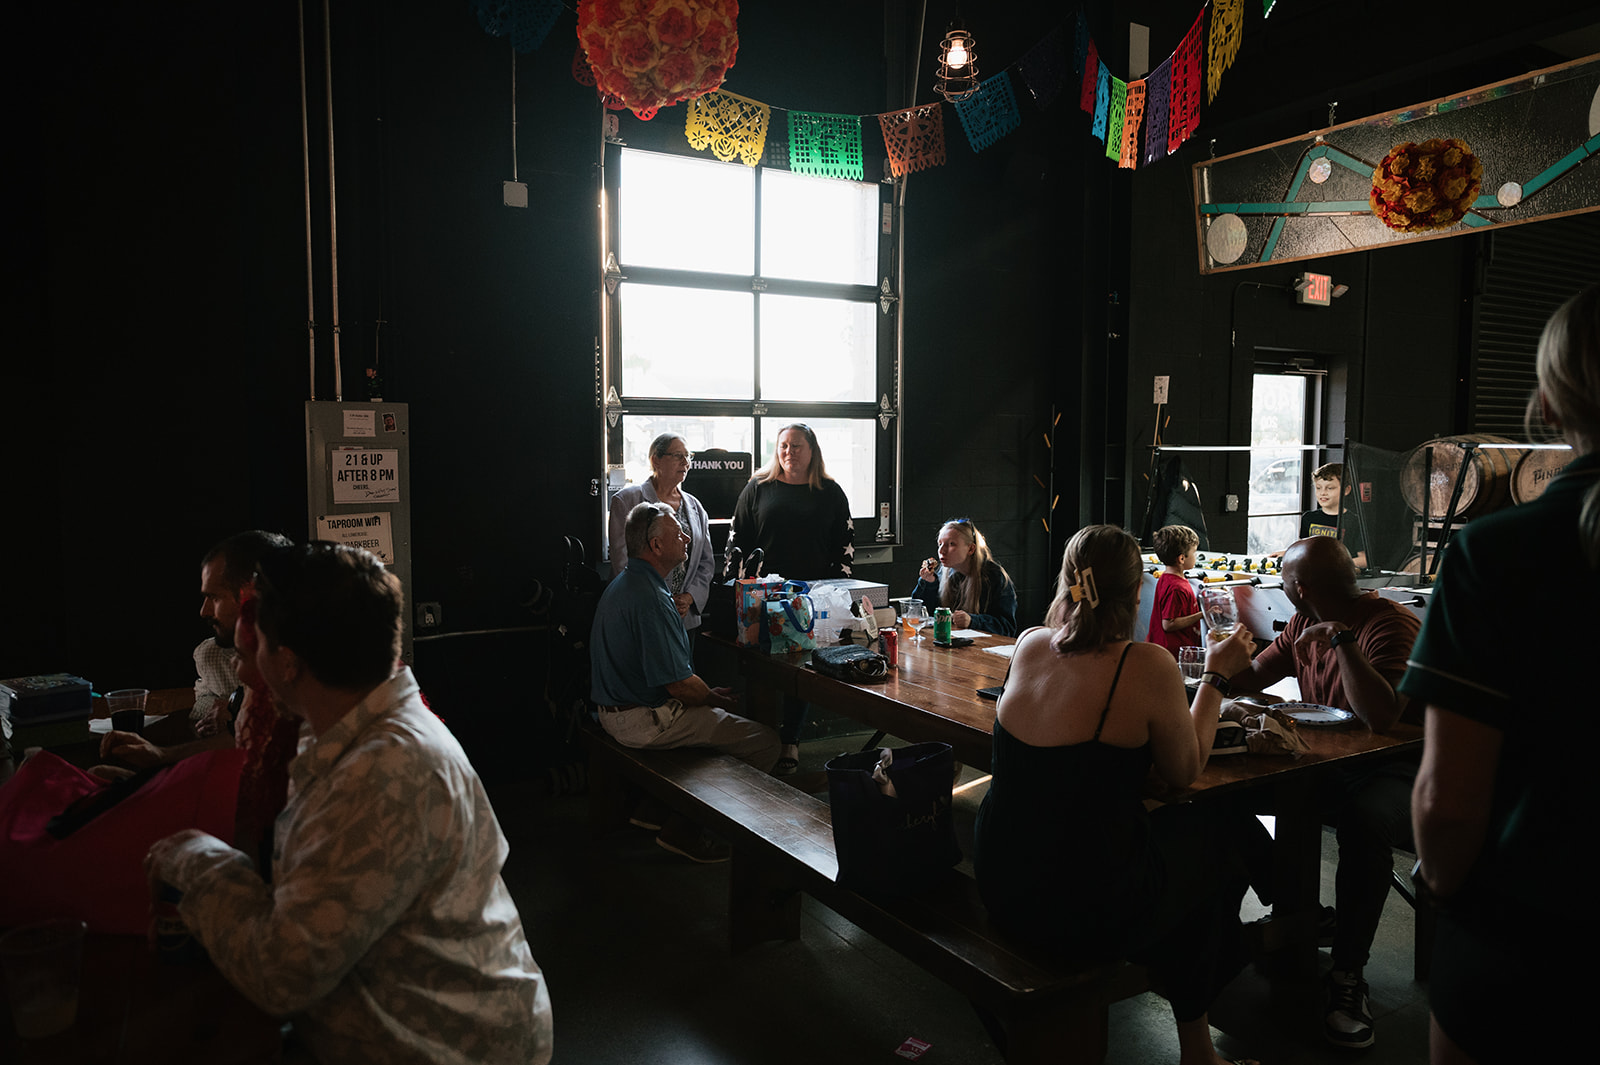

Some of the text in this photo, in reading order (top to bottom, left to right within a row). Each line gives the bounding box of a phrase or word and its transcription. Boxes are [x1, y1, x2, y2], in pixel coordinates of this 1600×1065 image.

[1308, 274, 1329, 301] EXIT
[346, 454, 383, 465] 21 & UP
[690, 460, 744, 470] THANK YOU
[337, 469, 394, 481] AFTER 8 PM
[327, 517, 381, 529] TAPROOM WIFI
[343, 539, 380, 549] PARKBEER
